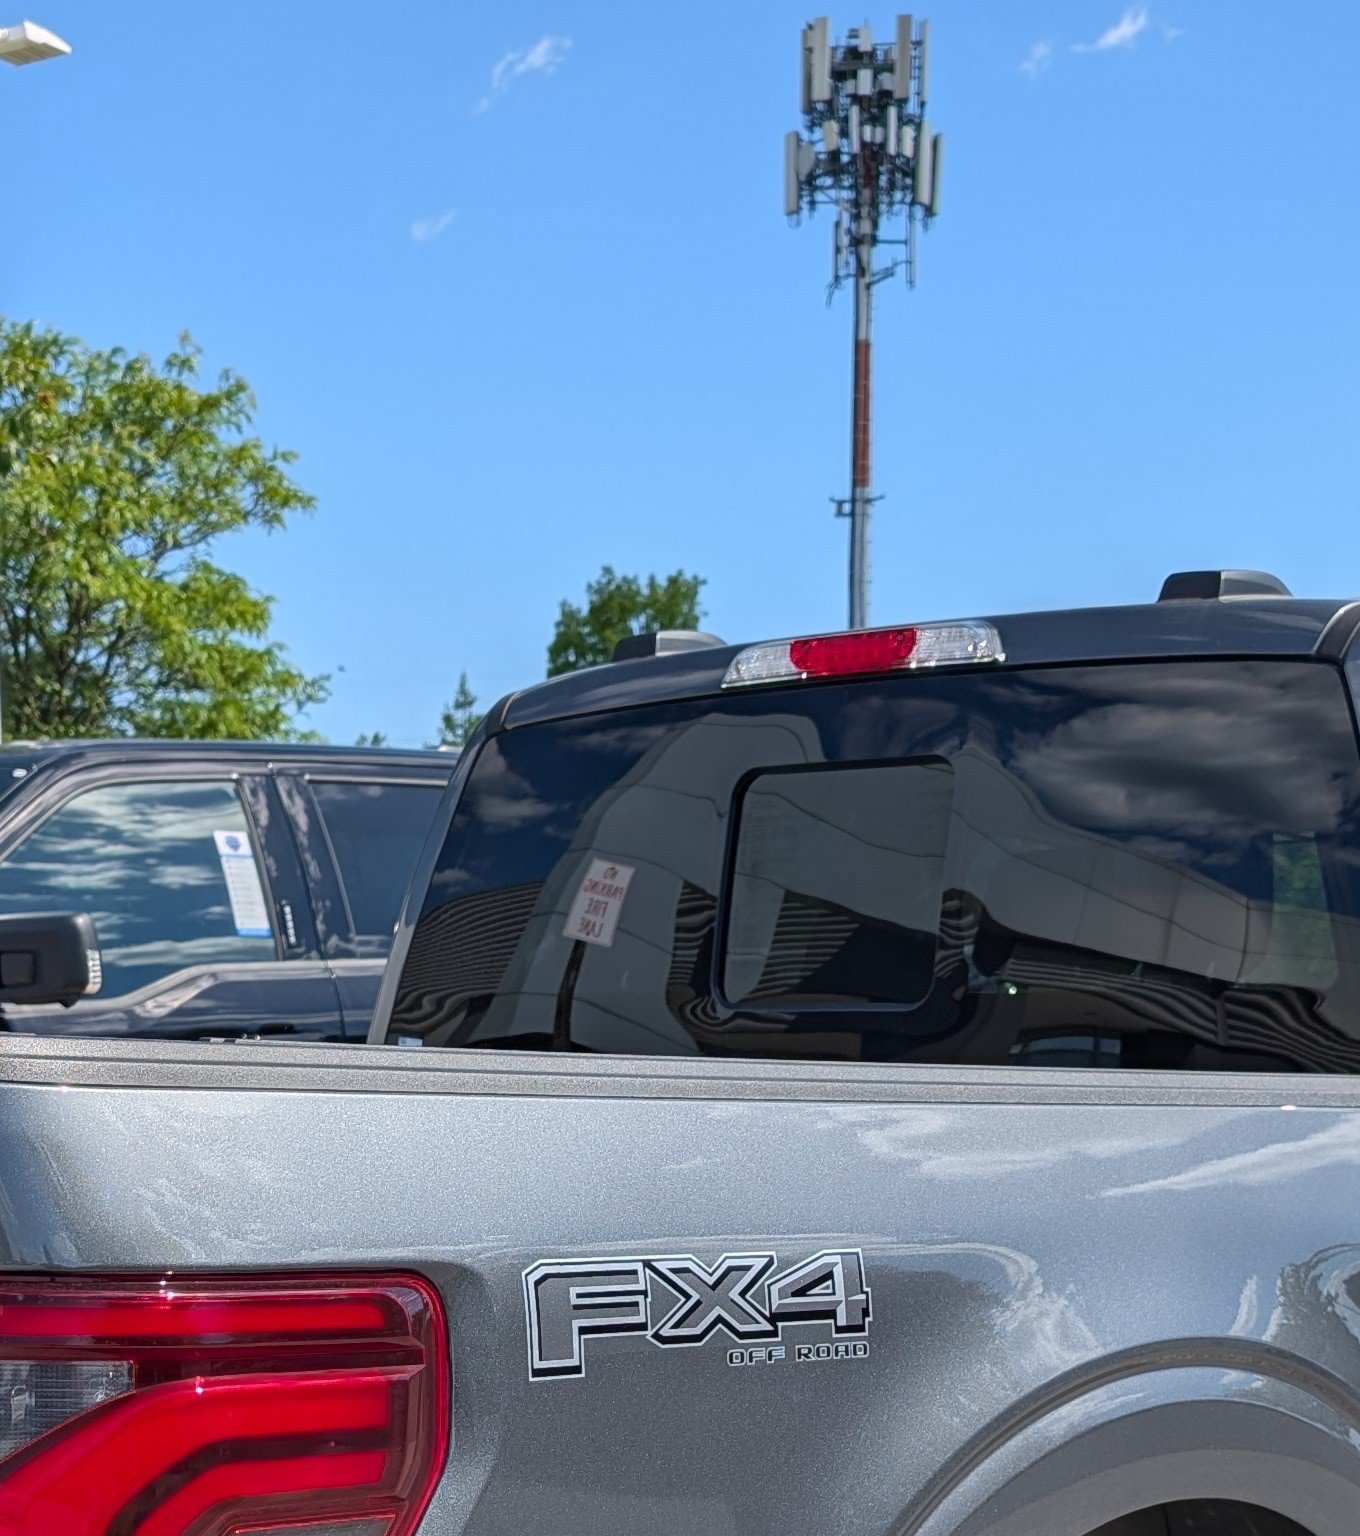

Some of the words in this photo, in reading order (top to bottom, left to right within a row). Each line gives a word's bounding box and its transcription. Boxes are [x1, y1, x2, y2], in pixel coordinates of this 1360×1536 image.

[522, 1248, 873, 1382] FX4
[727, 1347, 786, 1367] OFF
[795, 1340, 871, 1363] ROAD
